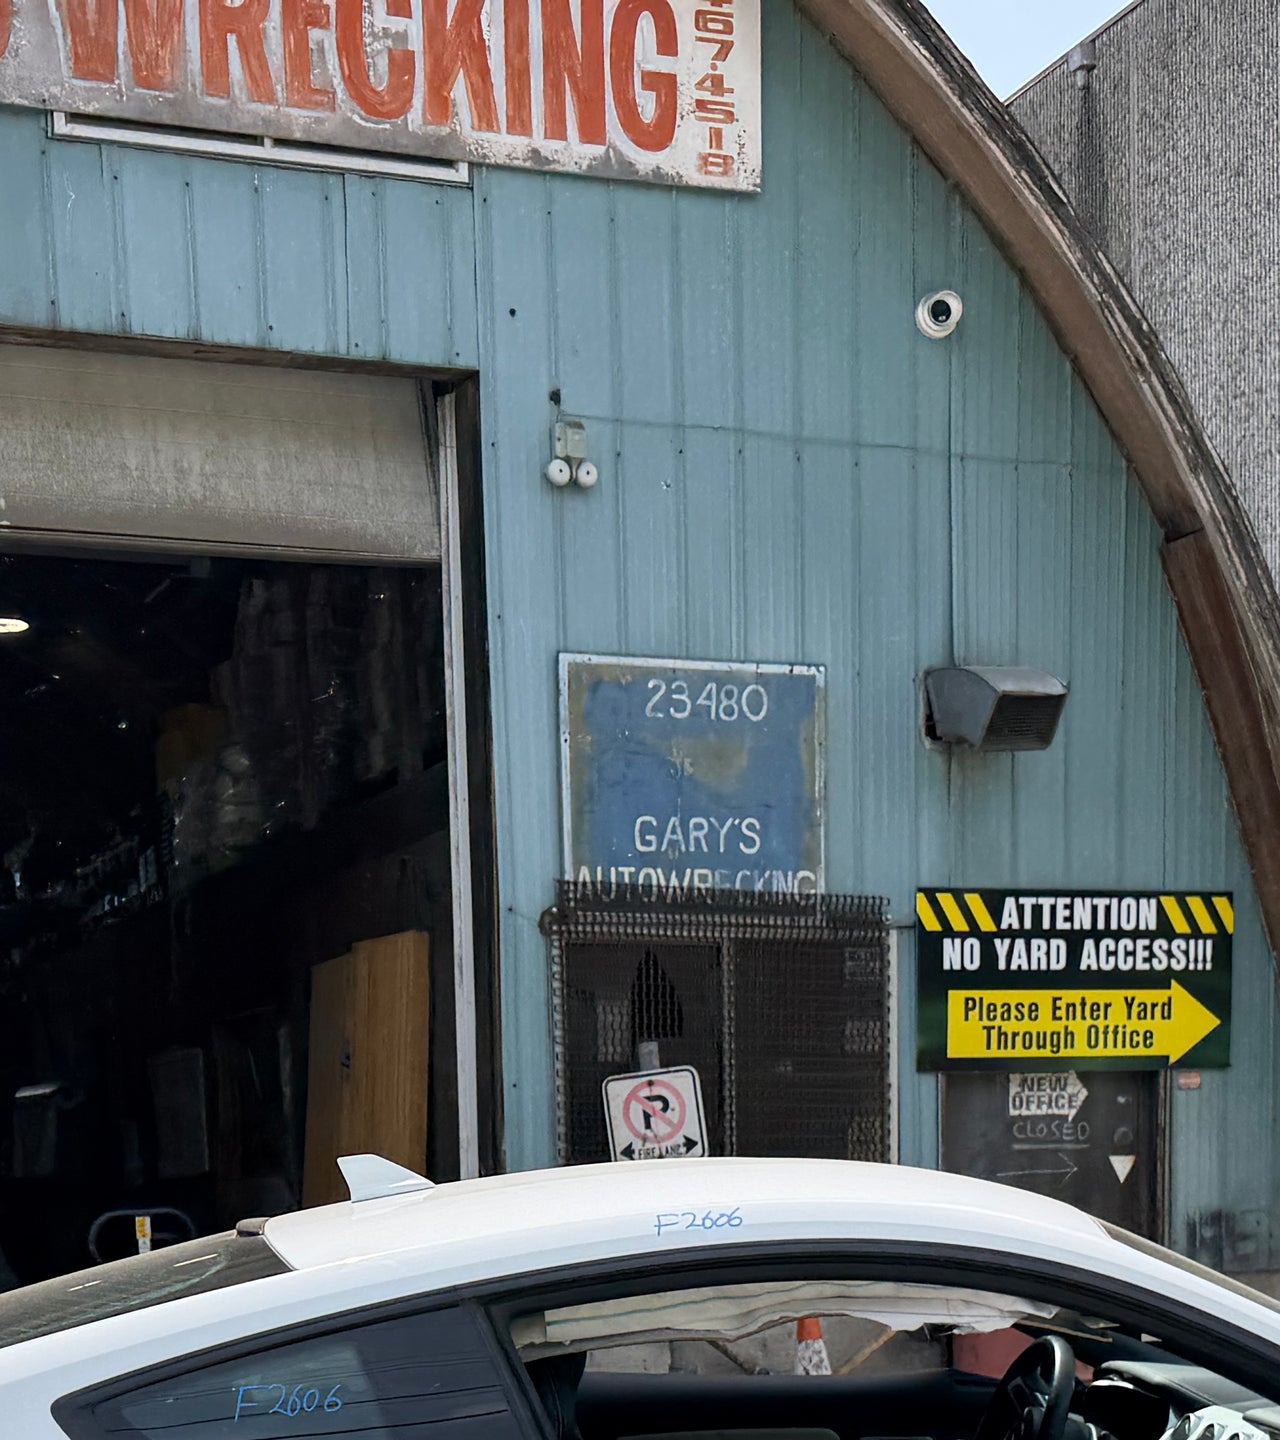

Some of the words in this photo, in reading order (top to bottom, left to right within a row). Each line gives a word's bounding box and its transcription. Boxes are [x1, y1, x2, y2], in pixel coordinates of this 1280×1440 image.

[645, 679, 769, 722] 23480
[634, 815, 762, 855] GARY'S
[1000, 896, 1158, 931] ATTENTION
[942, 938, 981, 971] NO
[994, 939, 1068, 971] YARD
[1079, 939, 1213, 971] ACCESS!!!
[963, 997, 1039, 1022] Please
[1051, 996, 1113, 1022] Enter
[1123, 996, 1173, 1021] Yard
[982, 1025, 1075, 1054] Through
[1086, 1025, 1155, 1050] Office
[1019, 1075, 1067, 1092] NEW
[1011, 1091, 1080, 1111] OFFICE
[1013, 1120, 1090, 1141] CLOSED
[654, 1206, 743, 1237] F2606
[234, 1383, 343, 1424] F2606
